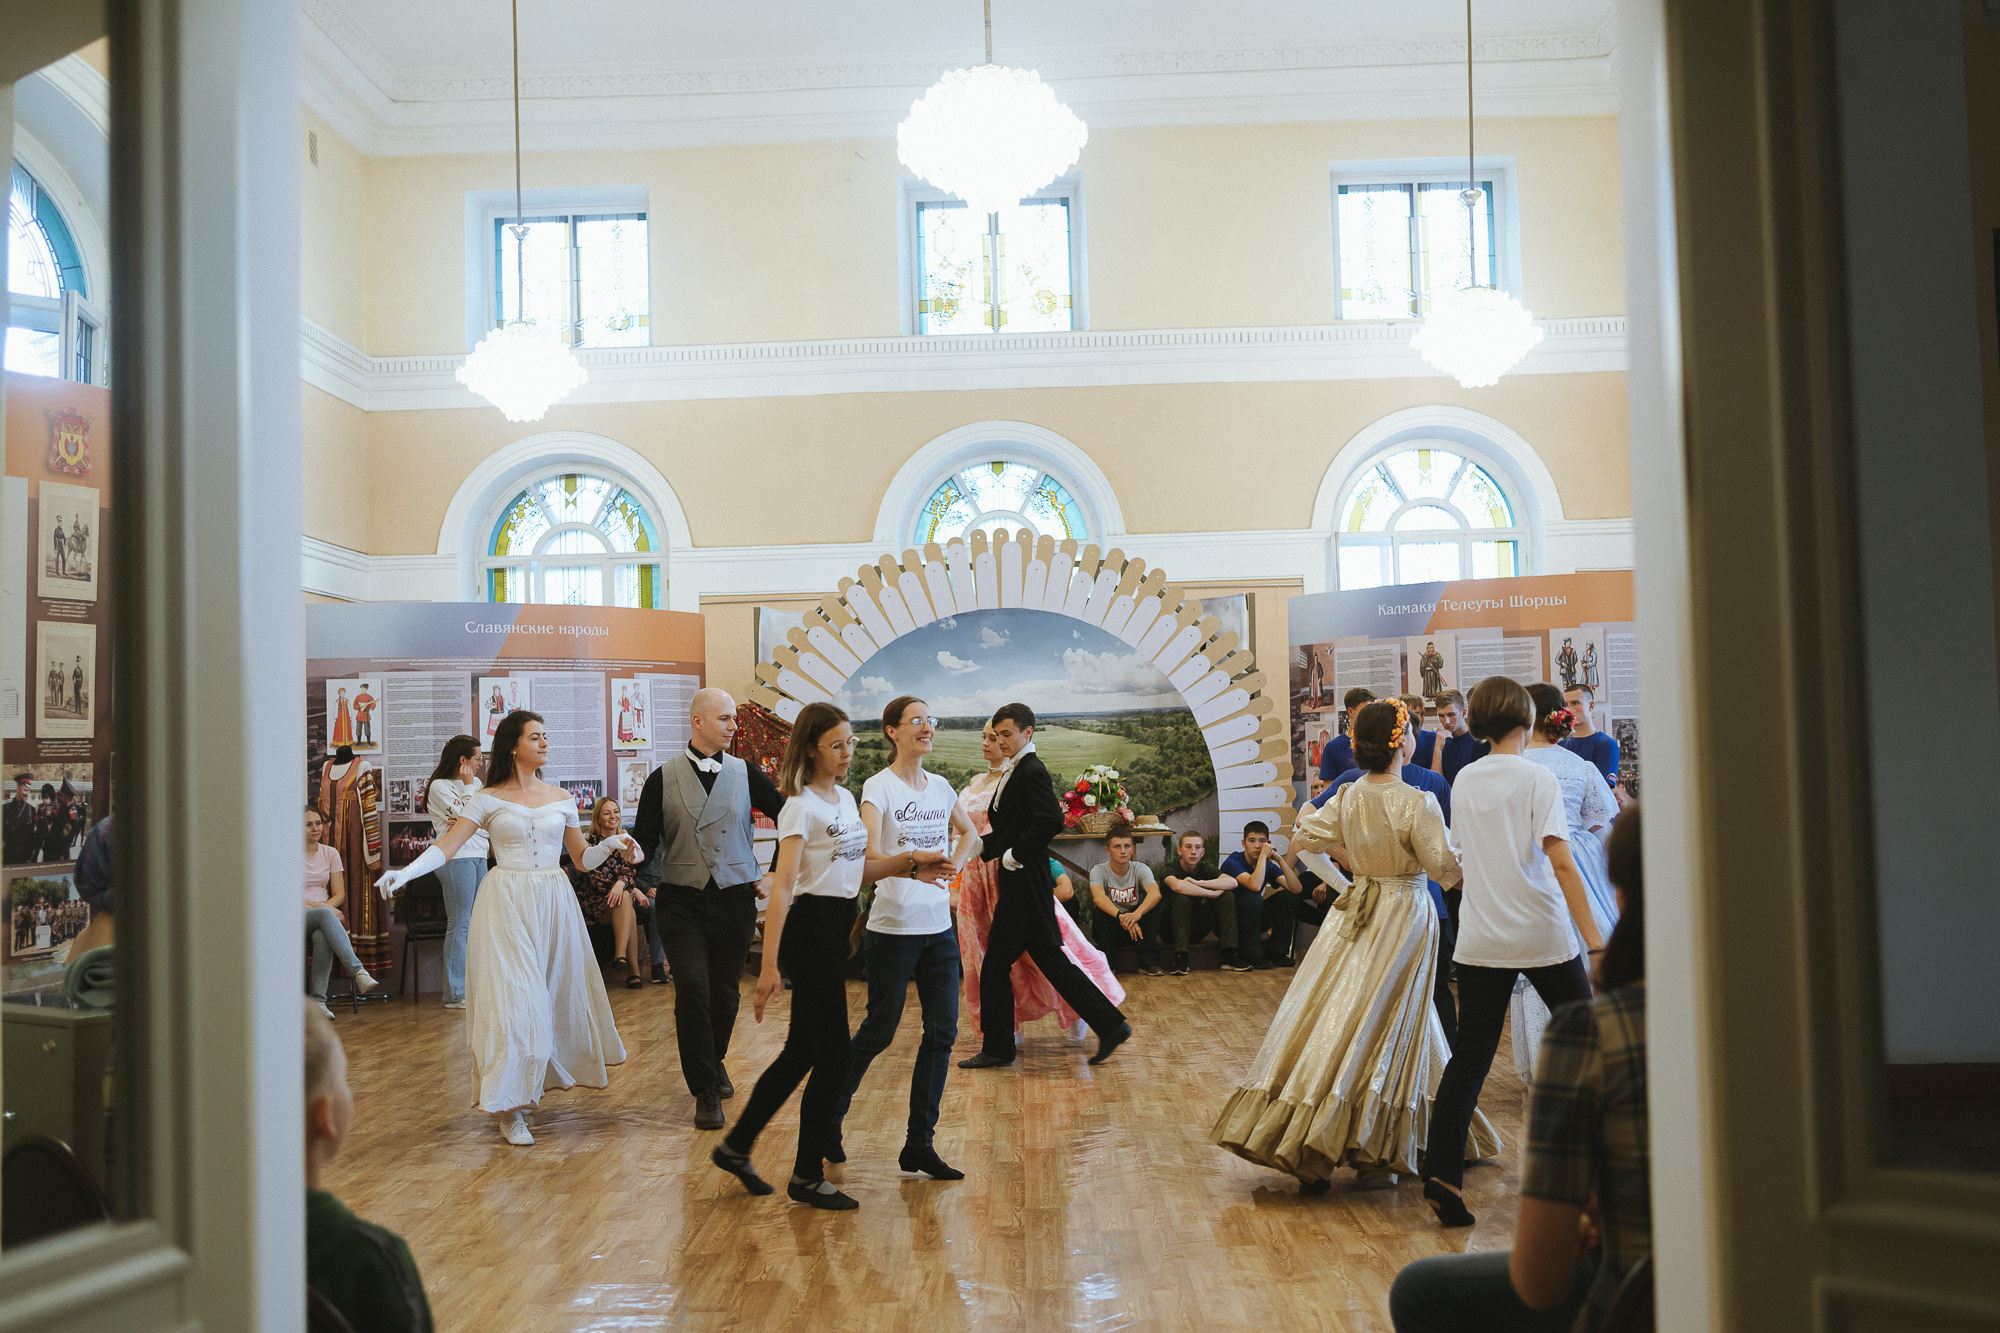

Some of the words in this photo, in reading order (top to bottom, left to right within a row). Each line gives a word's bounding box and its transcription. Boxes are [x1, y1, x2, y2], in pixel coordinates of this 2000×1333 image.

[1377, 602, 1437, 616] Калмаки
[1440, 598, 1504, 613] Телеуты
[1509, 595, 1567, 610] Шорцы
[464, 621, 554, 634] Славянские
[559, 624, 609, 637] народы
